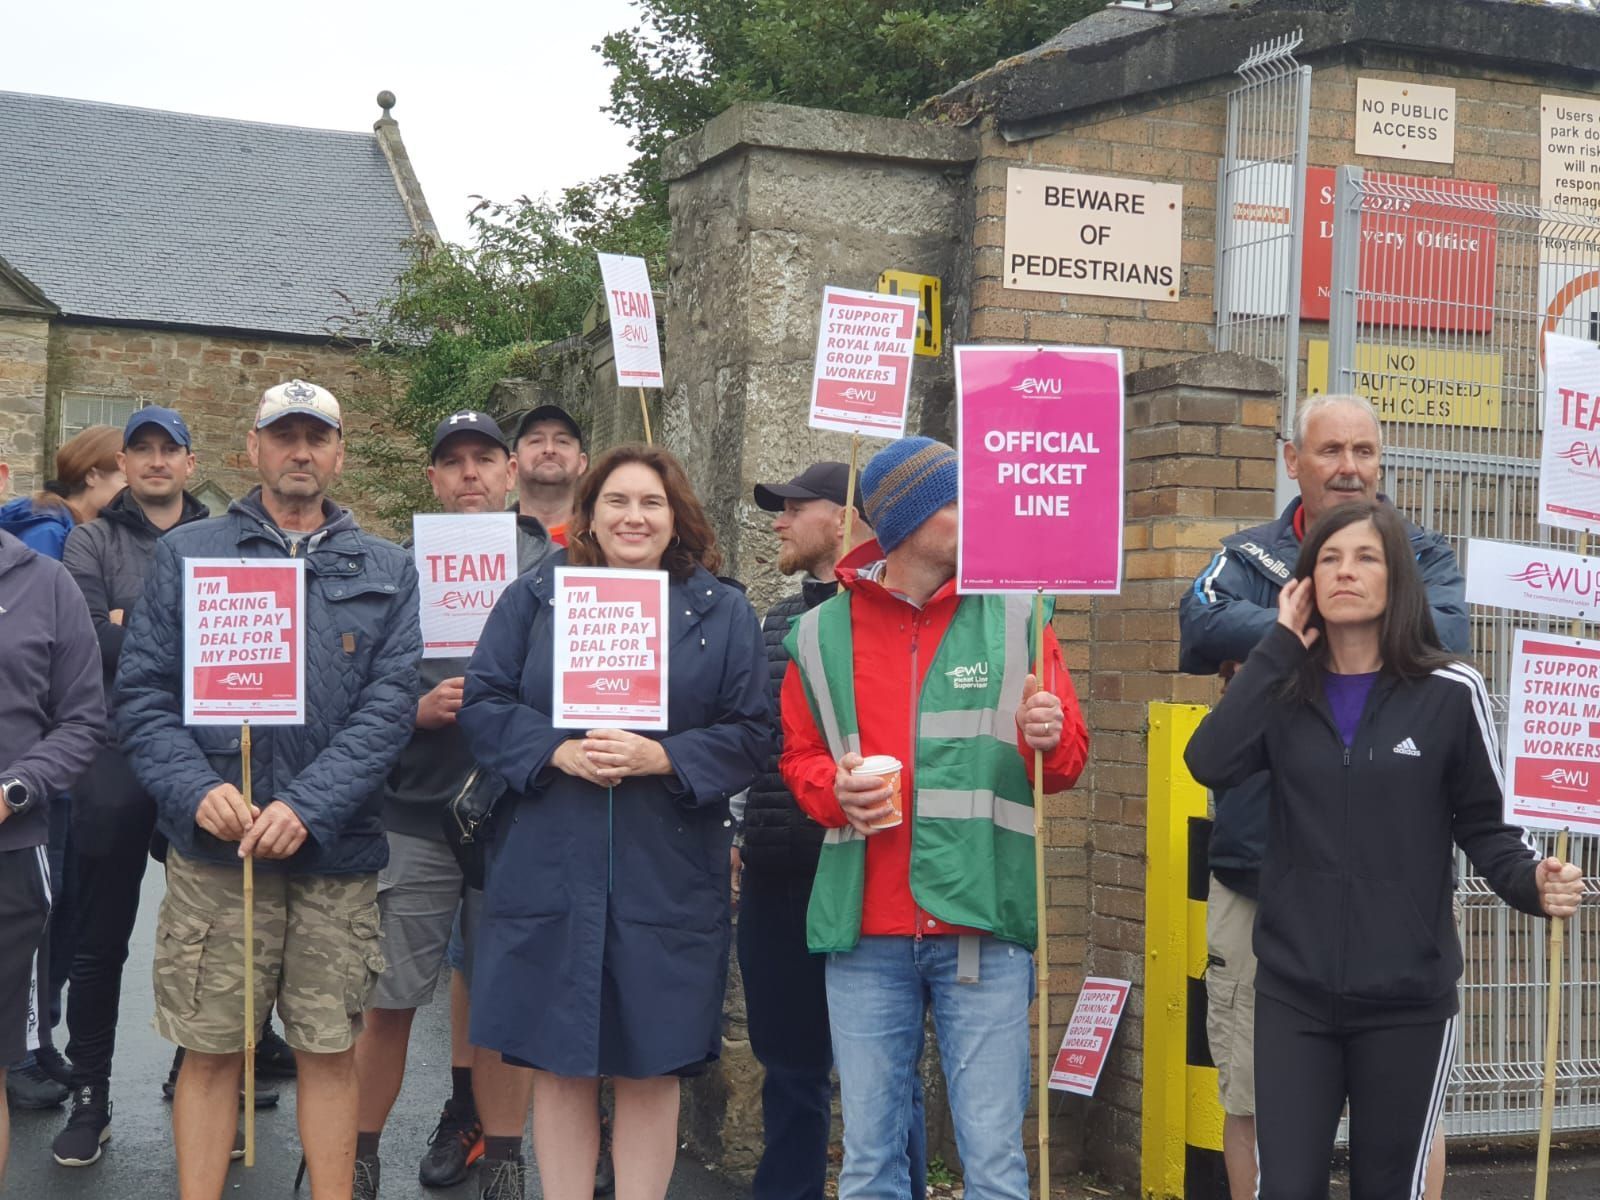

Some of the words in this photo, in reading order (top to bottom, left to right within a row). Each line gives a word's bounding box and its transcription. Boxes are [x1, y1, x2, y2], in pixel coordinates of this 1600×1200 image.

[1362, 98, 1385, 114] NO
[1391, 103, 1450, 121] PUBLIC
[1556, 107, 1593, 123] Users
[1373, 122, 1438, 141] ACCESS
[1551, 126, 1579, 139] park
[1548, 143, 1575, 154] own
[1564, 160, 1585, 173] will
[1044, 186, 1145, 215] BEWARE
[1080, 224, 1111, 246] OF
[1417, 230, 1479, 252] Office
[1011, 253, 1173, 287] PEDESTRIANS
[611, 289, 650, 319] TEAM
[829, 308, 834, 318] I
[837, 308, 898, 324] SUPPORT
[619, 325, 648, 343] CWU
[827, 322, 891, 338] STRIKING
[827, 338, 870, 351] ROYAL
[874, 341, 906, 353] MAIL
[826, 352, 873, 365] GROUP
[1386, 353, 1415, 372] NO
[825, 366, 890, 381] WORKERS
[1012, 378, 1062, 395] CWU
[840, 388, 877, 402] CWU
[984, 430, 1100, 453] OFFICIAL
[998, 463, 1087, 485] PICKET
[1014, 495, 1070, 516] LINE
[426, 554, 506, 583] TEAM
[1507, 561, 1591, 595] CWU
[197, 582, 221, 595] I'M
[198, 597, 268, 612] BACKING
[433, 590, 494, 609] CWU
[567, 591, 590, 604] I'M
[568, 606, 635, 619] BACKING
[198, 616, 209, 629] A
[213, 615, 248, 628] FAIR
[252, 613, 284, 627] PAY
[568, 624, 578, 636] A
[583, 622, 617, 635] FAIR
[620, 622, 650, 635] PAY
[200, 633, 237, 646] DEAL
[242, 631, 273, 644] FOR
[570, 640, 606, 652] DEAL
[610, 638, 640, 651] FOR
[200, 650, 225, 663] MY
[228, 647, 283, 662] POSTIE
[570, 656, 594, 668] MY
[597, 654, 649, 668] POSTIE
[945, 662, 988, 677] CWU
[1524, 660, 1530, 674] I
[1534, 660, 1600, 679] SUPPOR
[218, 672, 263, 686] CWU
[588, 678, 630, 691] CWU
[1524, 680, 1600, 698] STRIKING
[1524, 700, 1578, 717] ROYAL
[1524, 720, 1582, 736] GROUP
[1393, 747, 1421, 756] adidas
[1541, 768, 1589, 787] CWU
[1083, 992, 1117, 1002] SUPPORT
[1076, 1004, 1108, 1013] STRIKING
[1073, 1015, 1093, 1024] ROYAL
[1095, 1017, 1114, 1026] MAIL
[1069, 1027, 1092, 1036] GROUP
[1065, 1039, 1099, 1049] WORKERS
